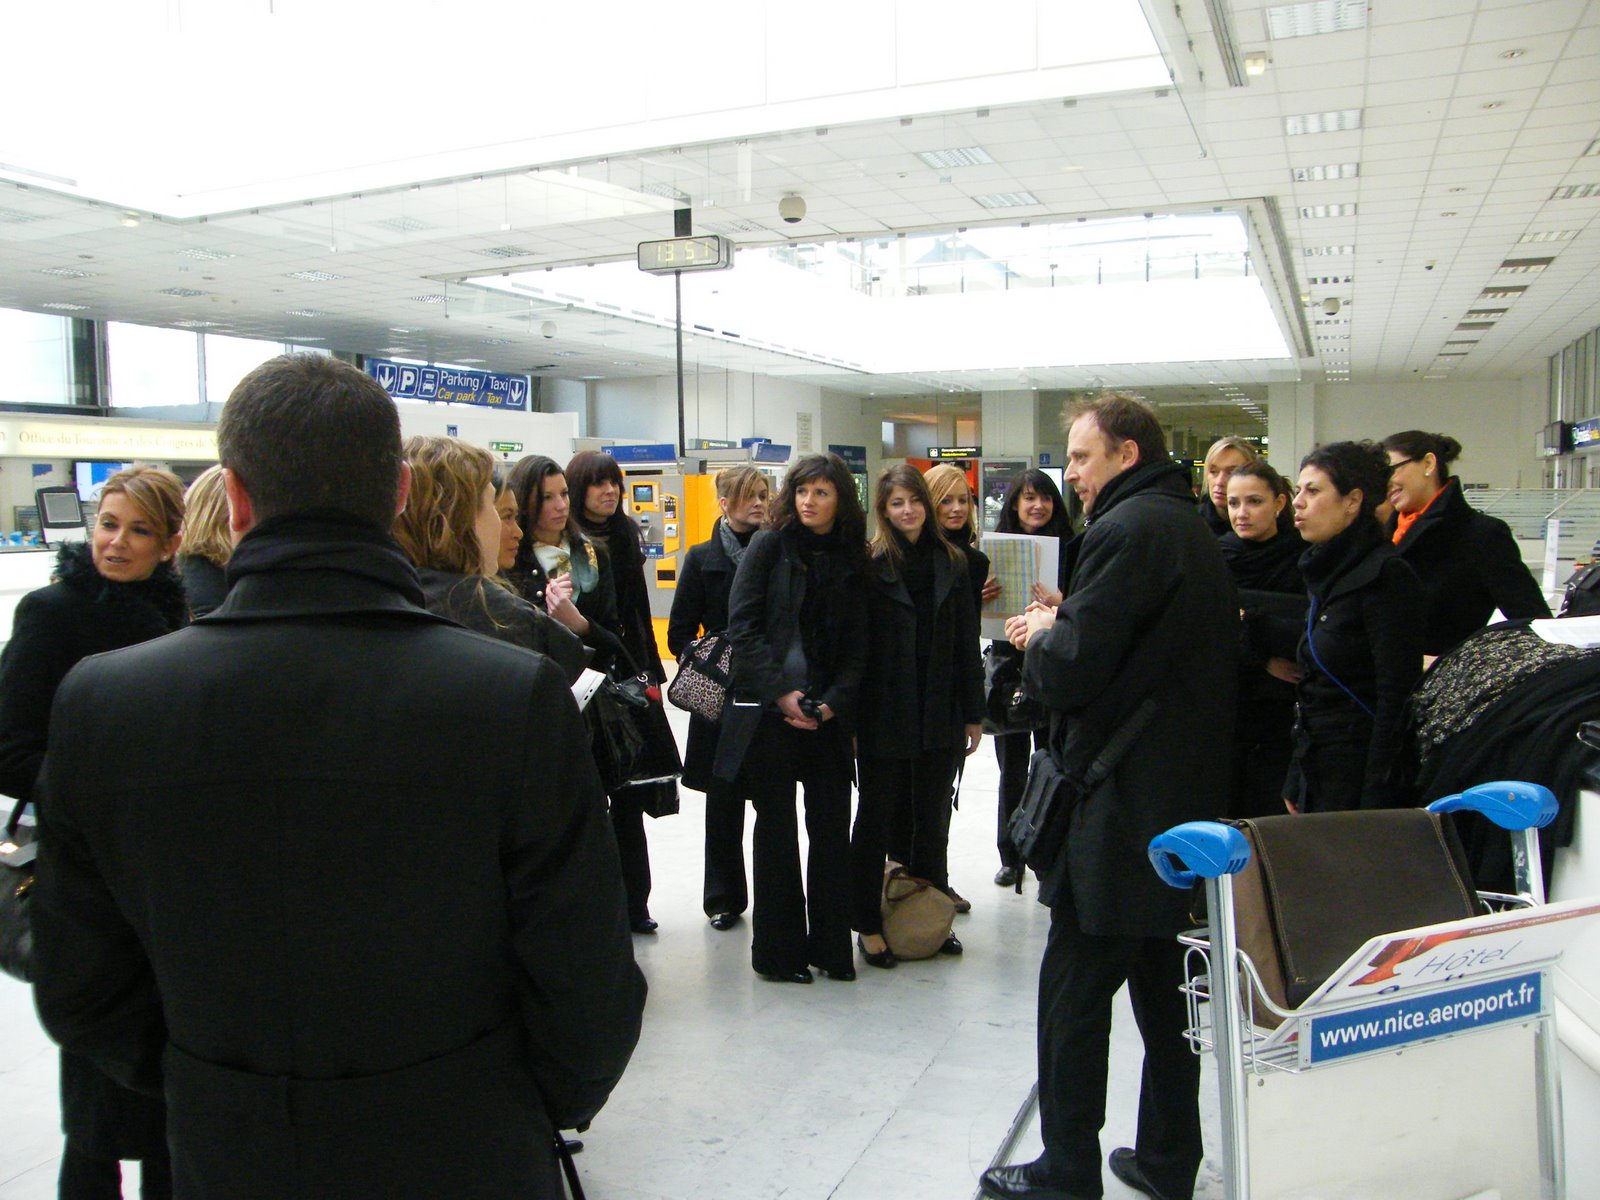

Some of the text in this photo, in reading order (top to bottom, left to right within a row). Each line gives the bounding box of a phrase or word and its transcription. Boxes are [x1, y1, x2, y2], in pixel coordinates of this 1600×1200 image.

[440, 370, 480, 392] Parking
[489, 375, 509, 391] Taxi
[437, 387, 454, 400] Car
[455, 390, 476, 402] park
[487, 392, 503, 404] Taxi
[19, 430, 53, 444] Office
[56, 432, 72, 445] du
[1414, 939, 1523, 977] Hôtel
[1319, 981, 1536, 1049] www.nice.aeroport.fr
